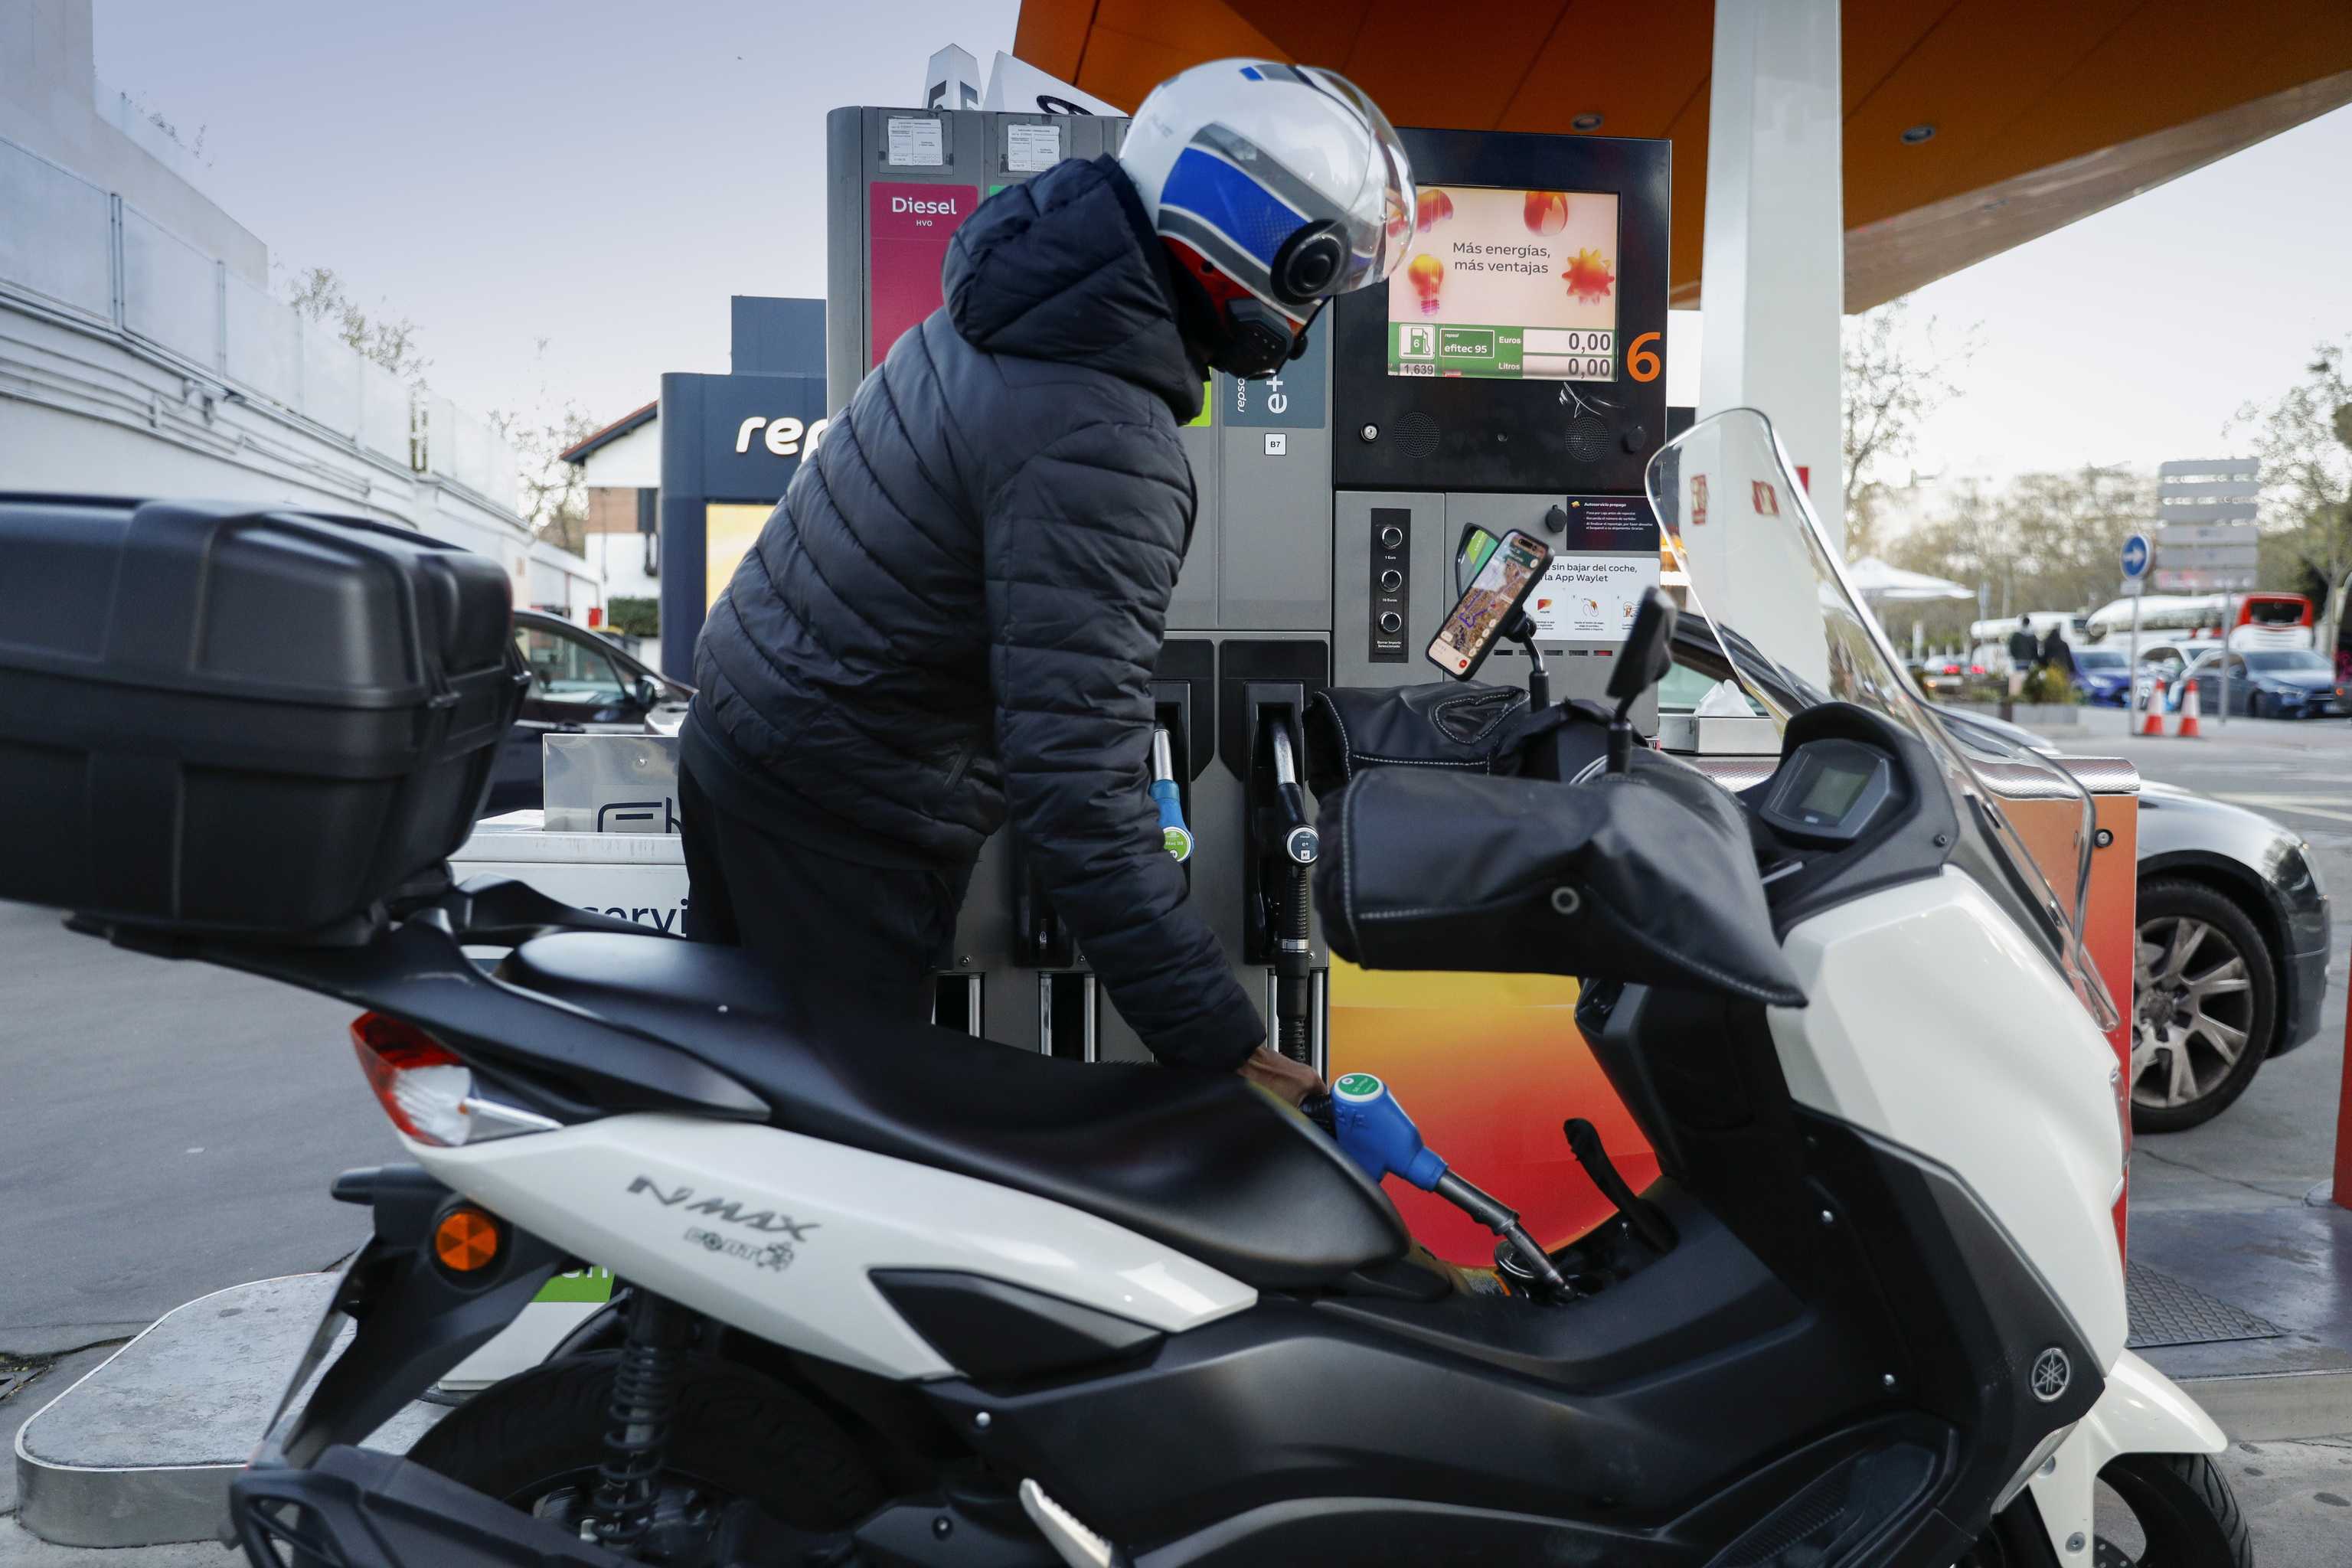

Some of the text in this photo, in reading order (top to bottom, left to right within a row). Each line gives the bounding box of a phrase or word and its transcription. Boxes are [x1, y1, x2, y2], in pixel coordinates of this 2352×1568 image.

[892, 197, 957, 214] Diesel
[1453, 242, 1550, 259] Más energías,
[1455, 259, 1548, 276] más ventajas
[1413, 339, 1420, 348] 6
[1499, 336, 1521, 344] Euros
[1569, 333, 1611, 354] 0,00
[1444, 344, 1473, 353] efitec
[1627, 332, 1661, 382] 6
[1404, 364, 1434, 376] 1,639
[1568, 358, 1610, 379] 0,00
[1567, 564, 1590, 573] bajar
[1609, 564, 1637, 573] coche,
[1555, 574, 1574, 582] App
[1576, 574, 1608, 583] Waylet
